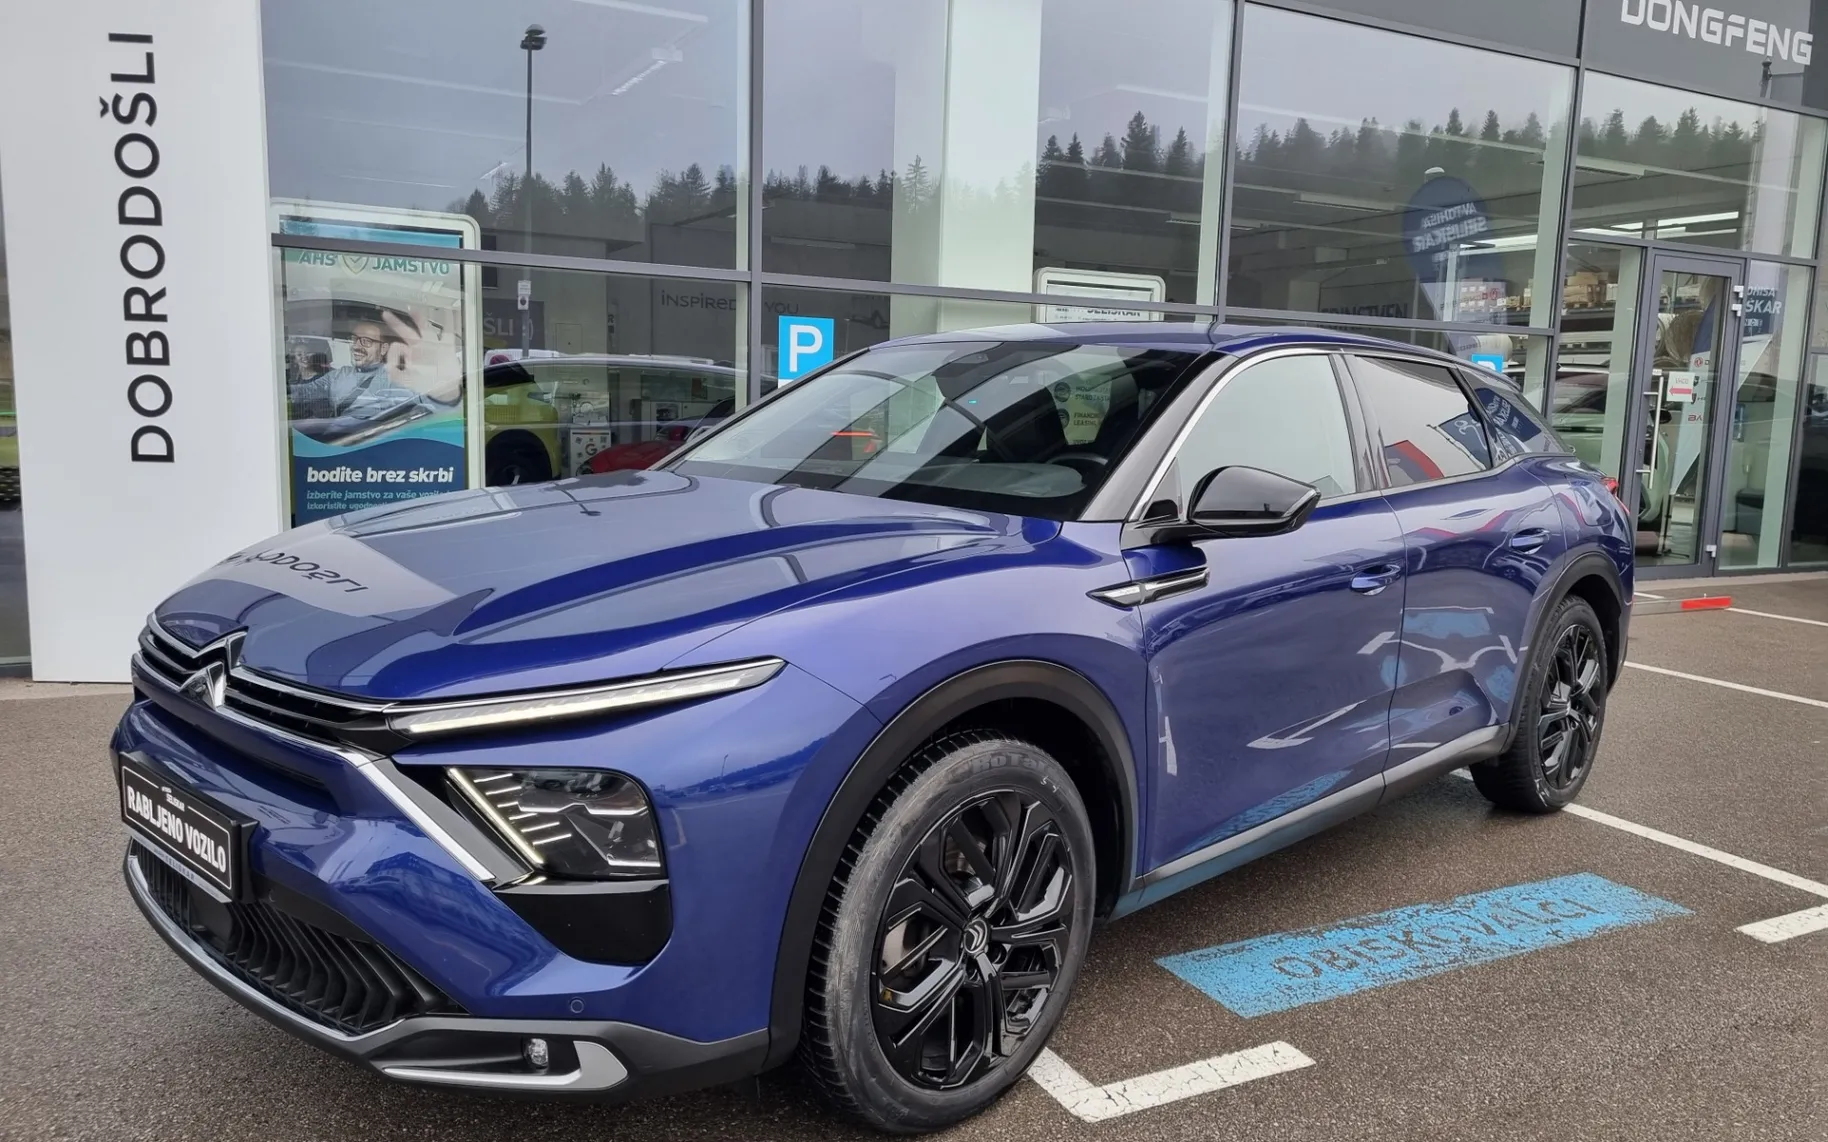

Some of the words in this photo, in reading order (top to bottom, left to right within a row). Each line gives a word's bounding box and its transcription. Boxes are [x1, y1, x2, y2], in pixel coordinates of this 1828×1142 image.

[1621, 0, 1813, 65] DONGFENG
[99, 33, 175, 463] DOBRODOŠLI
[372, 257, 450, 275] JAMSTVO
[789, 324, 823, 372] P
[306, 490, 343, 500] izberite
[344, 490, 381, 503] jamstvo
[396, 489, 417, 499] vaše
[307, 466, 362, 482] bodite
[366, 467, 406, 483] brez
[408, 467, 455, 483] skrbi
[127, 785, 184, 844] RABLJENO
[184, 822, 227, 873] VOZILO
